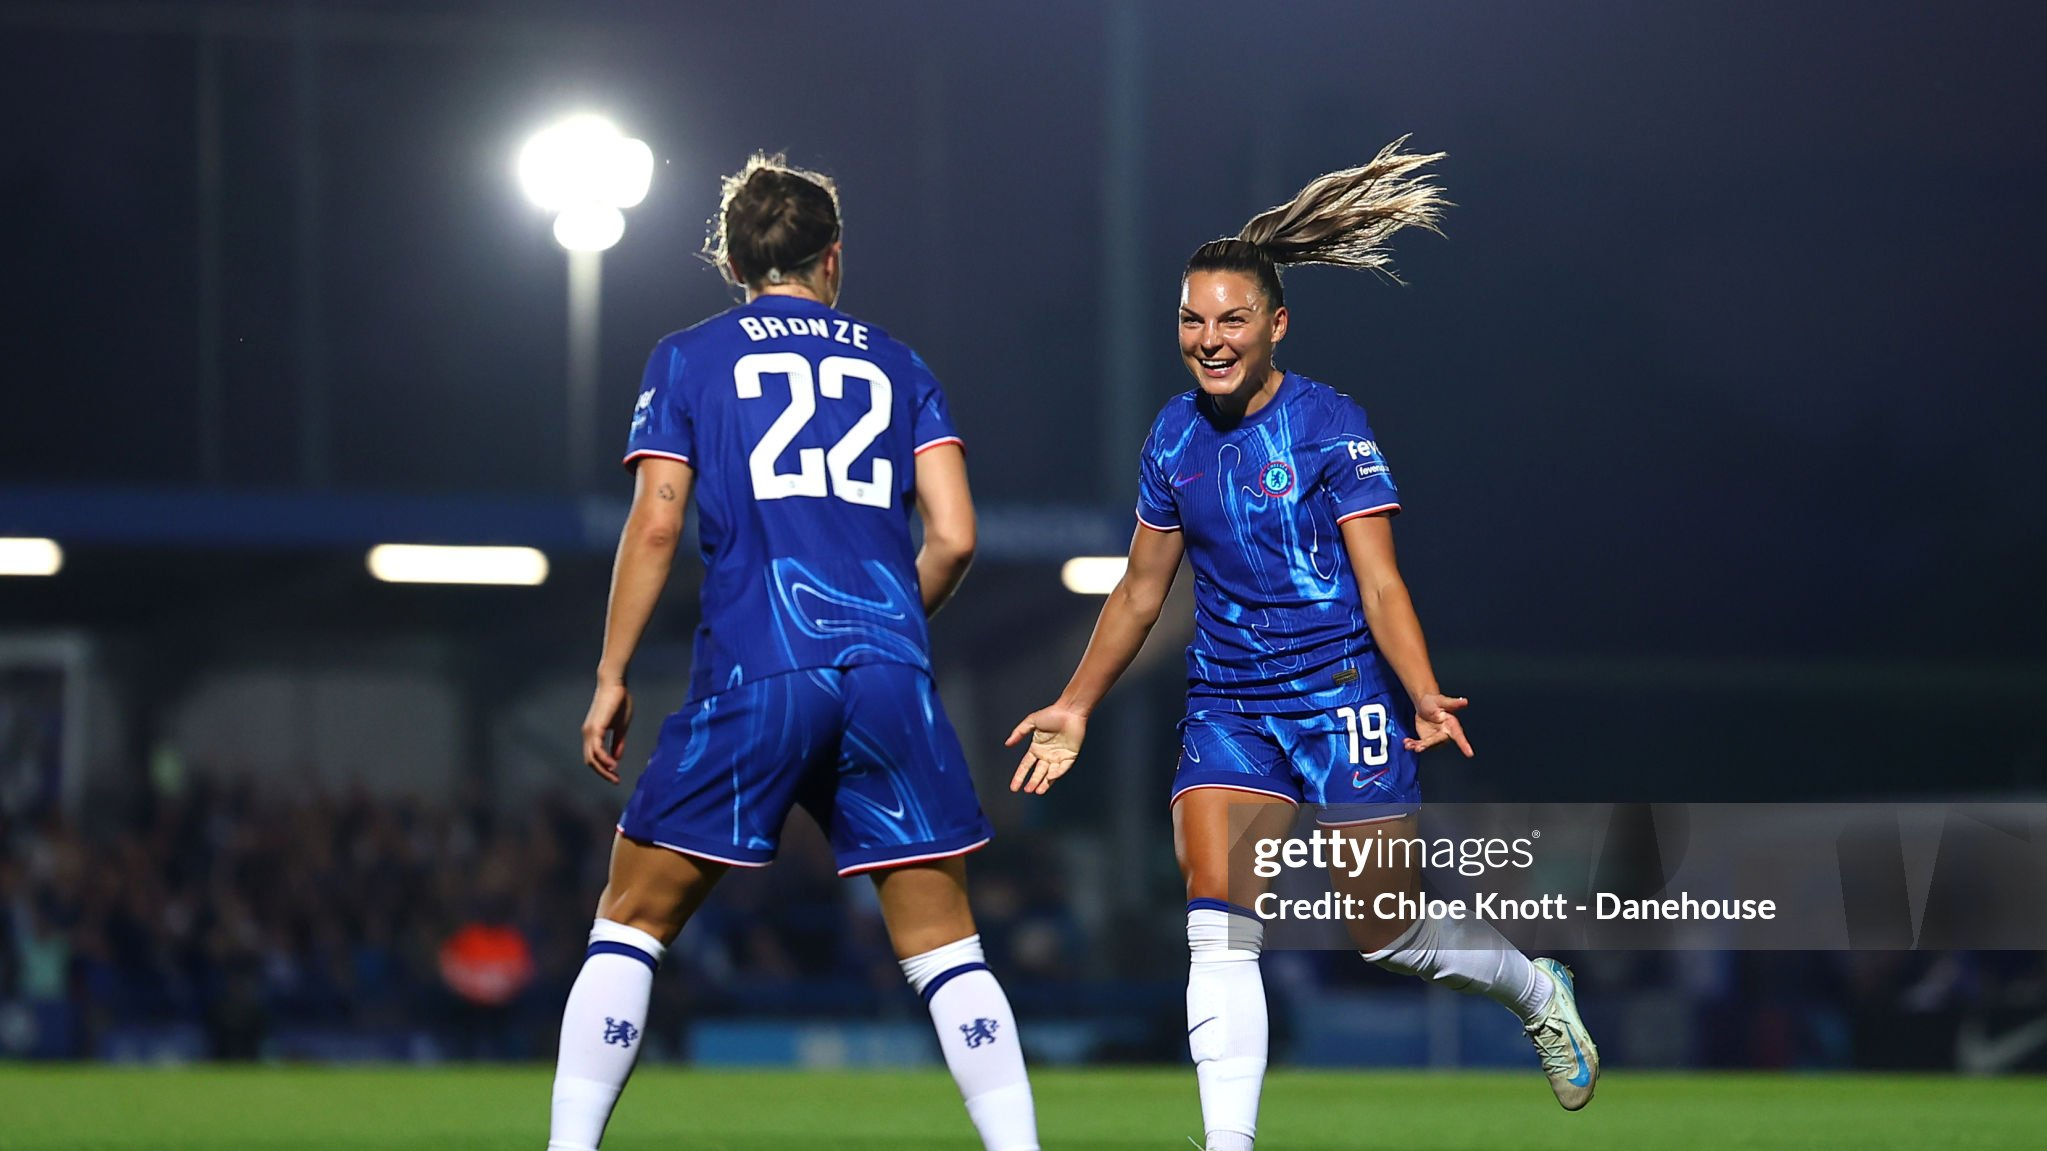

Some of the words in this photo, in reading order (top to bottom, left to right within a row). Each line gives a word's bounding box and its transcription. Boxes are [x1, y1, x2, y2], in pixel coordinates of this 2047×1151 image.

[740, 316, 868, 350] BRONZE
[734, 352, 893, 509] 22
[1348, 440, 1380, 460] fev
[1337, 703, 1388, 766] 19
